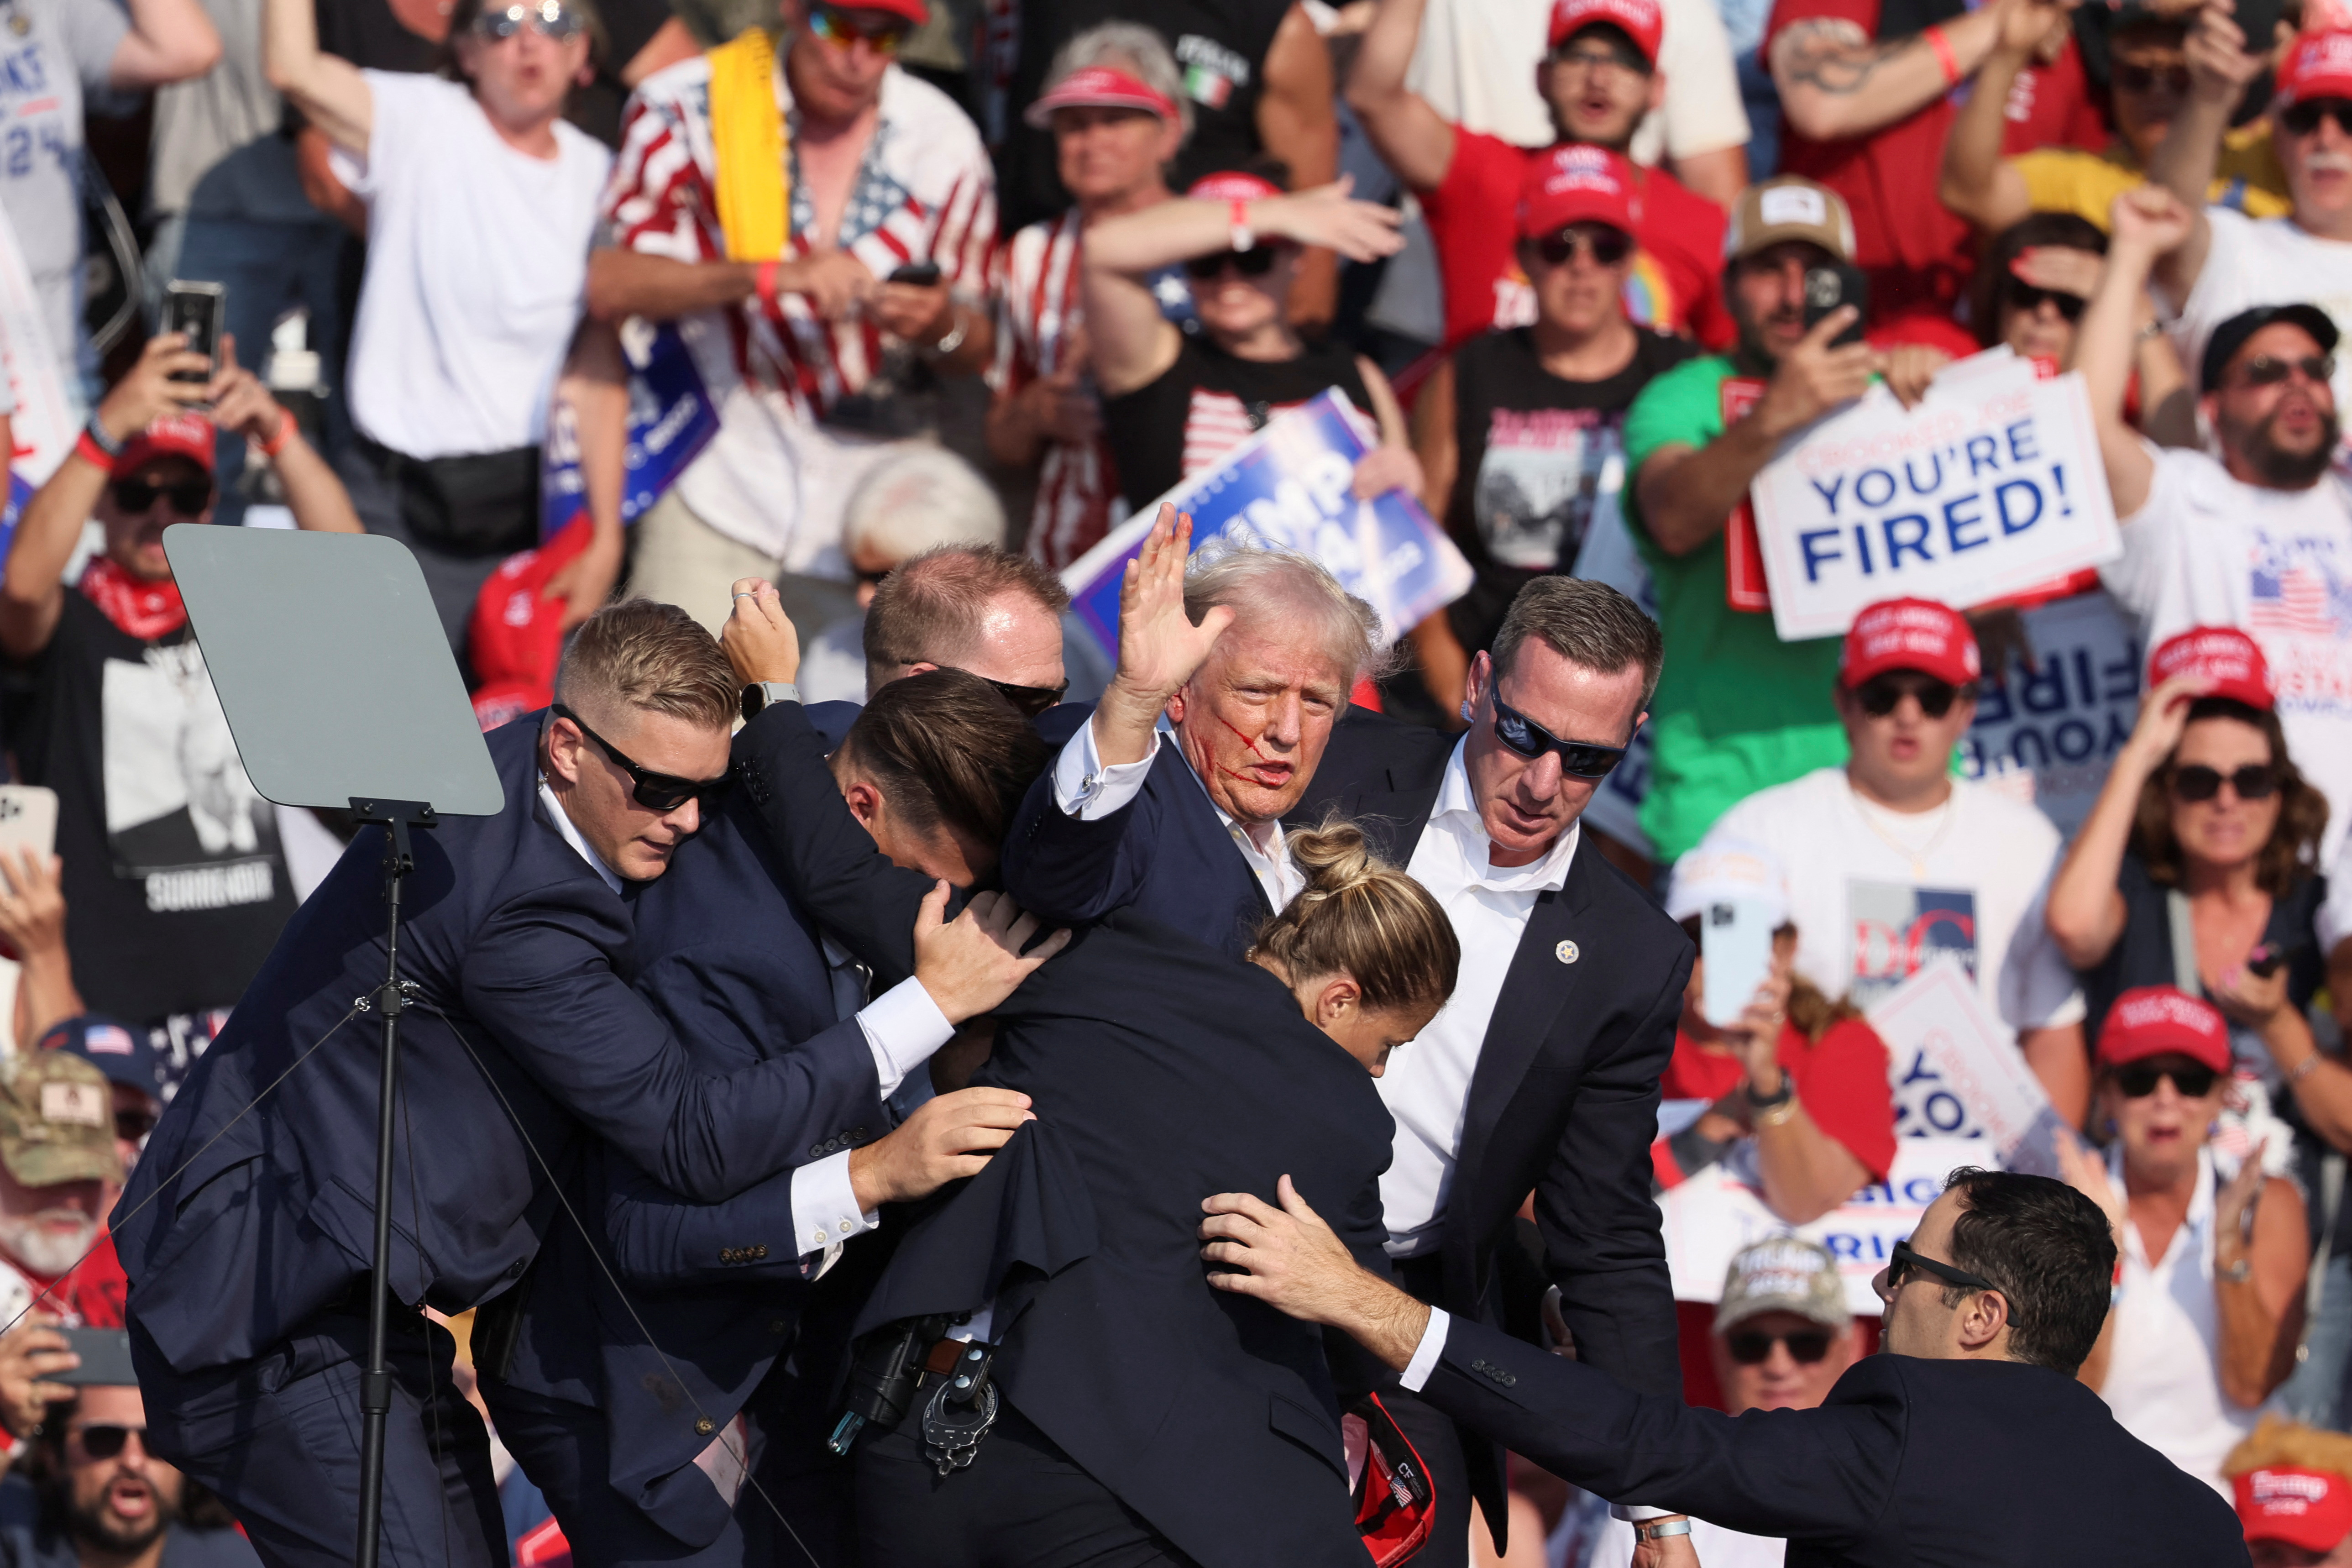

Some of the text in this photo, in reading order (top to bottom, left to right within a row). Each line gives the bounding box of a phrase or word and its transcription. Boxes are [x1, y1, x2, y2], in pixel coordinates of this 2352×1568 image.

[1812, 418, 2040, 515] YOU'RE
[1799, 465, 2073, 582] FIRED!
[1971, 638, 2141, 727] FIRE
[1902, 1049, 1983, 1138] YO
[1398, 1463, 1414, 1479] CF
